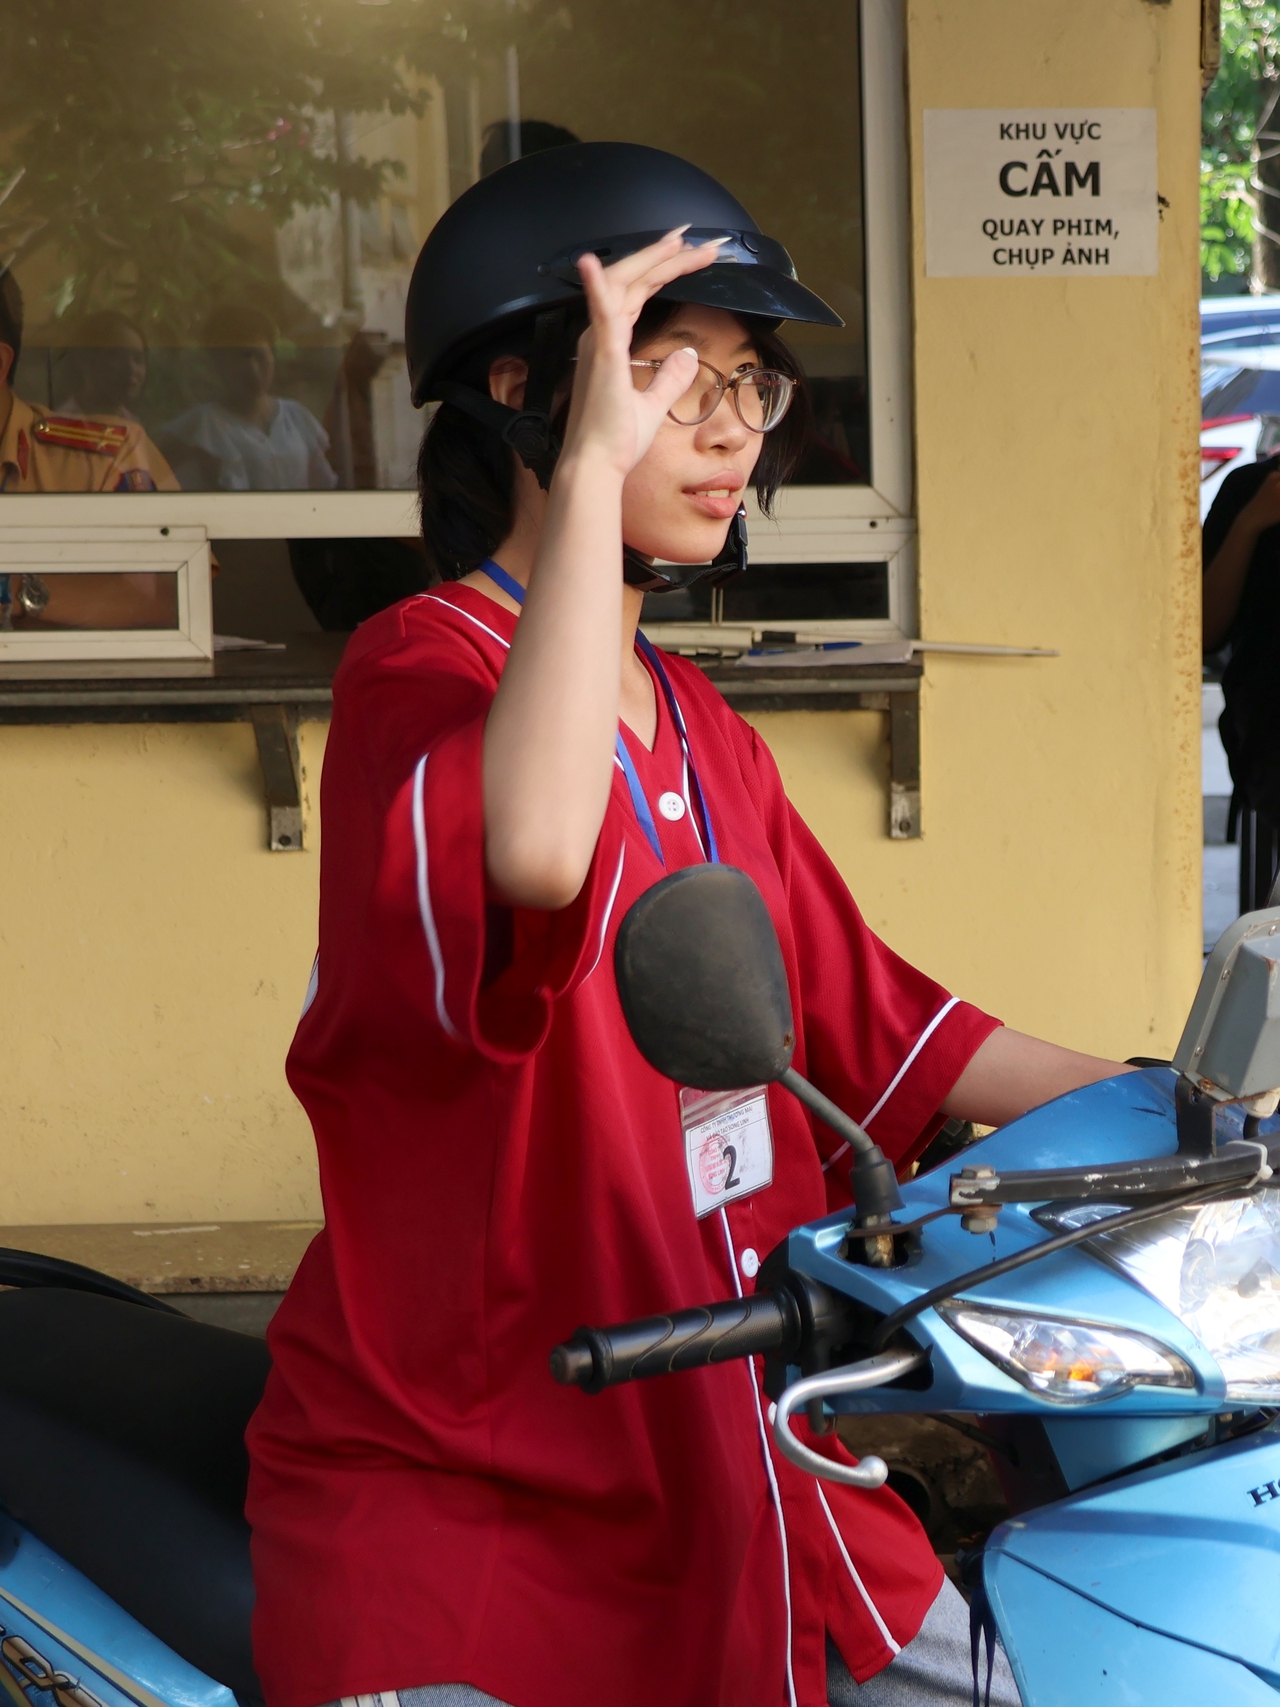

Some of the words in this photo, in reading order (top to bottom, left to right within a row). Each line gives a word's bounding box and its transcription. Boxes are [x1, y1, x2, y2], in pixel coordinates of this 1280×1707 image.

[1000, 122, 1047, 141] KHU
[1054, 119, 1102, 145] VỰC
[999, 148, 1101, 198] CẤM
[982, 218, 1045, 240] QUAY
[1053, 218, 1120, 240] PHIM,
[993, 247, 1055, 270] CHỤP
[1062, 242, 1110, 265] ẢNH
[722, 1145, 740, 1190] 2
